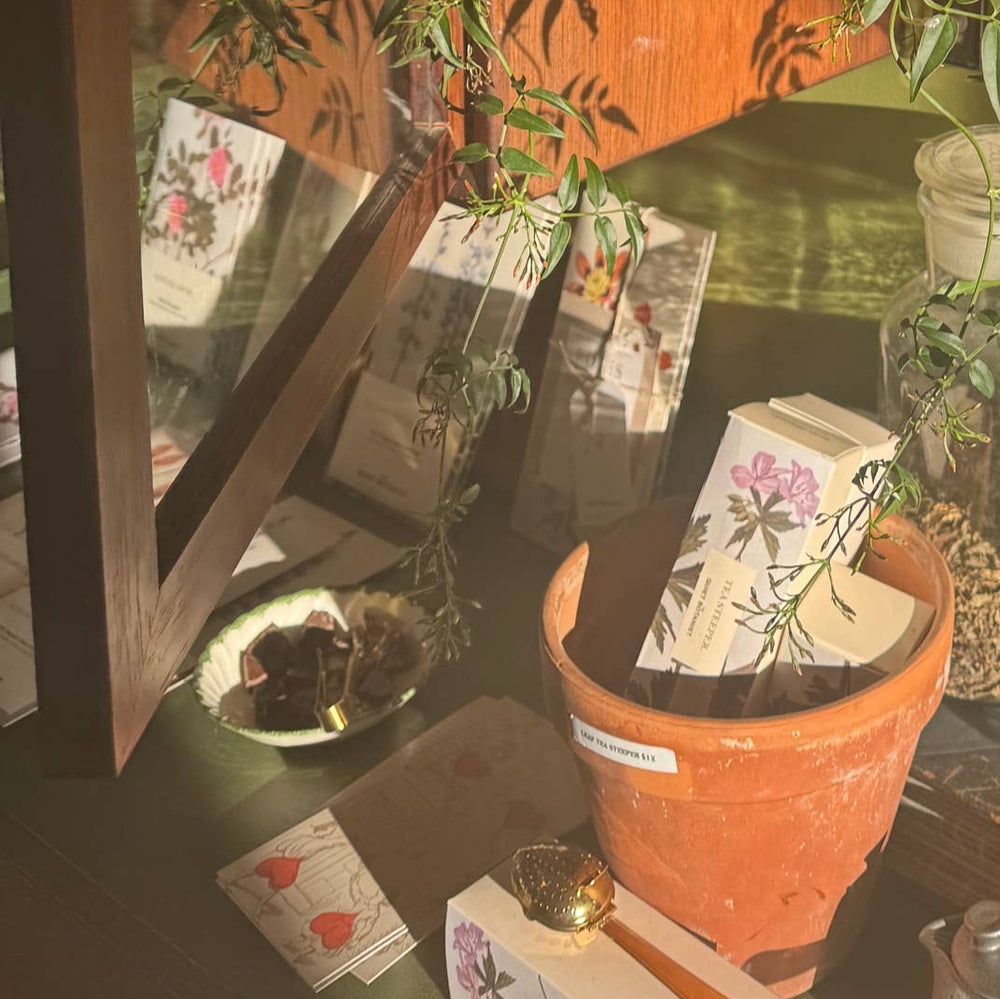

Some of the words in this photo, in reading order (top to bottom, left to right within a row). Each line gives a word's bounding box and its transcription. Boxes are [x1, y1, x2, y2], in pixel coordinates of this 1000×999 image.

[700, 601, 725, 652] STEEPER
[596, 737, 608, 749] TEA
[609, 744, 640, 759] STEEPER
